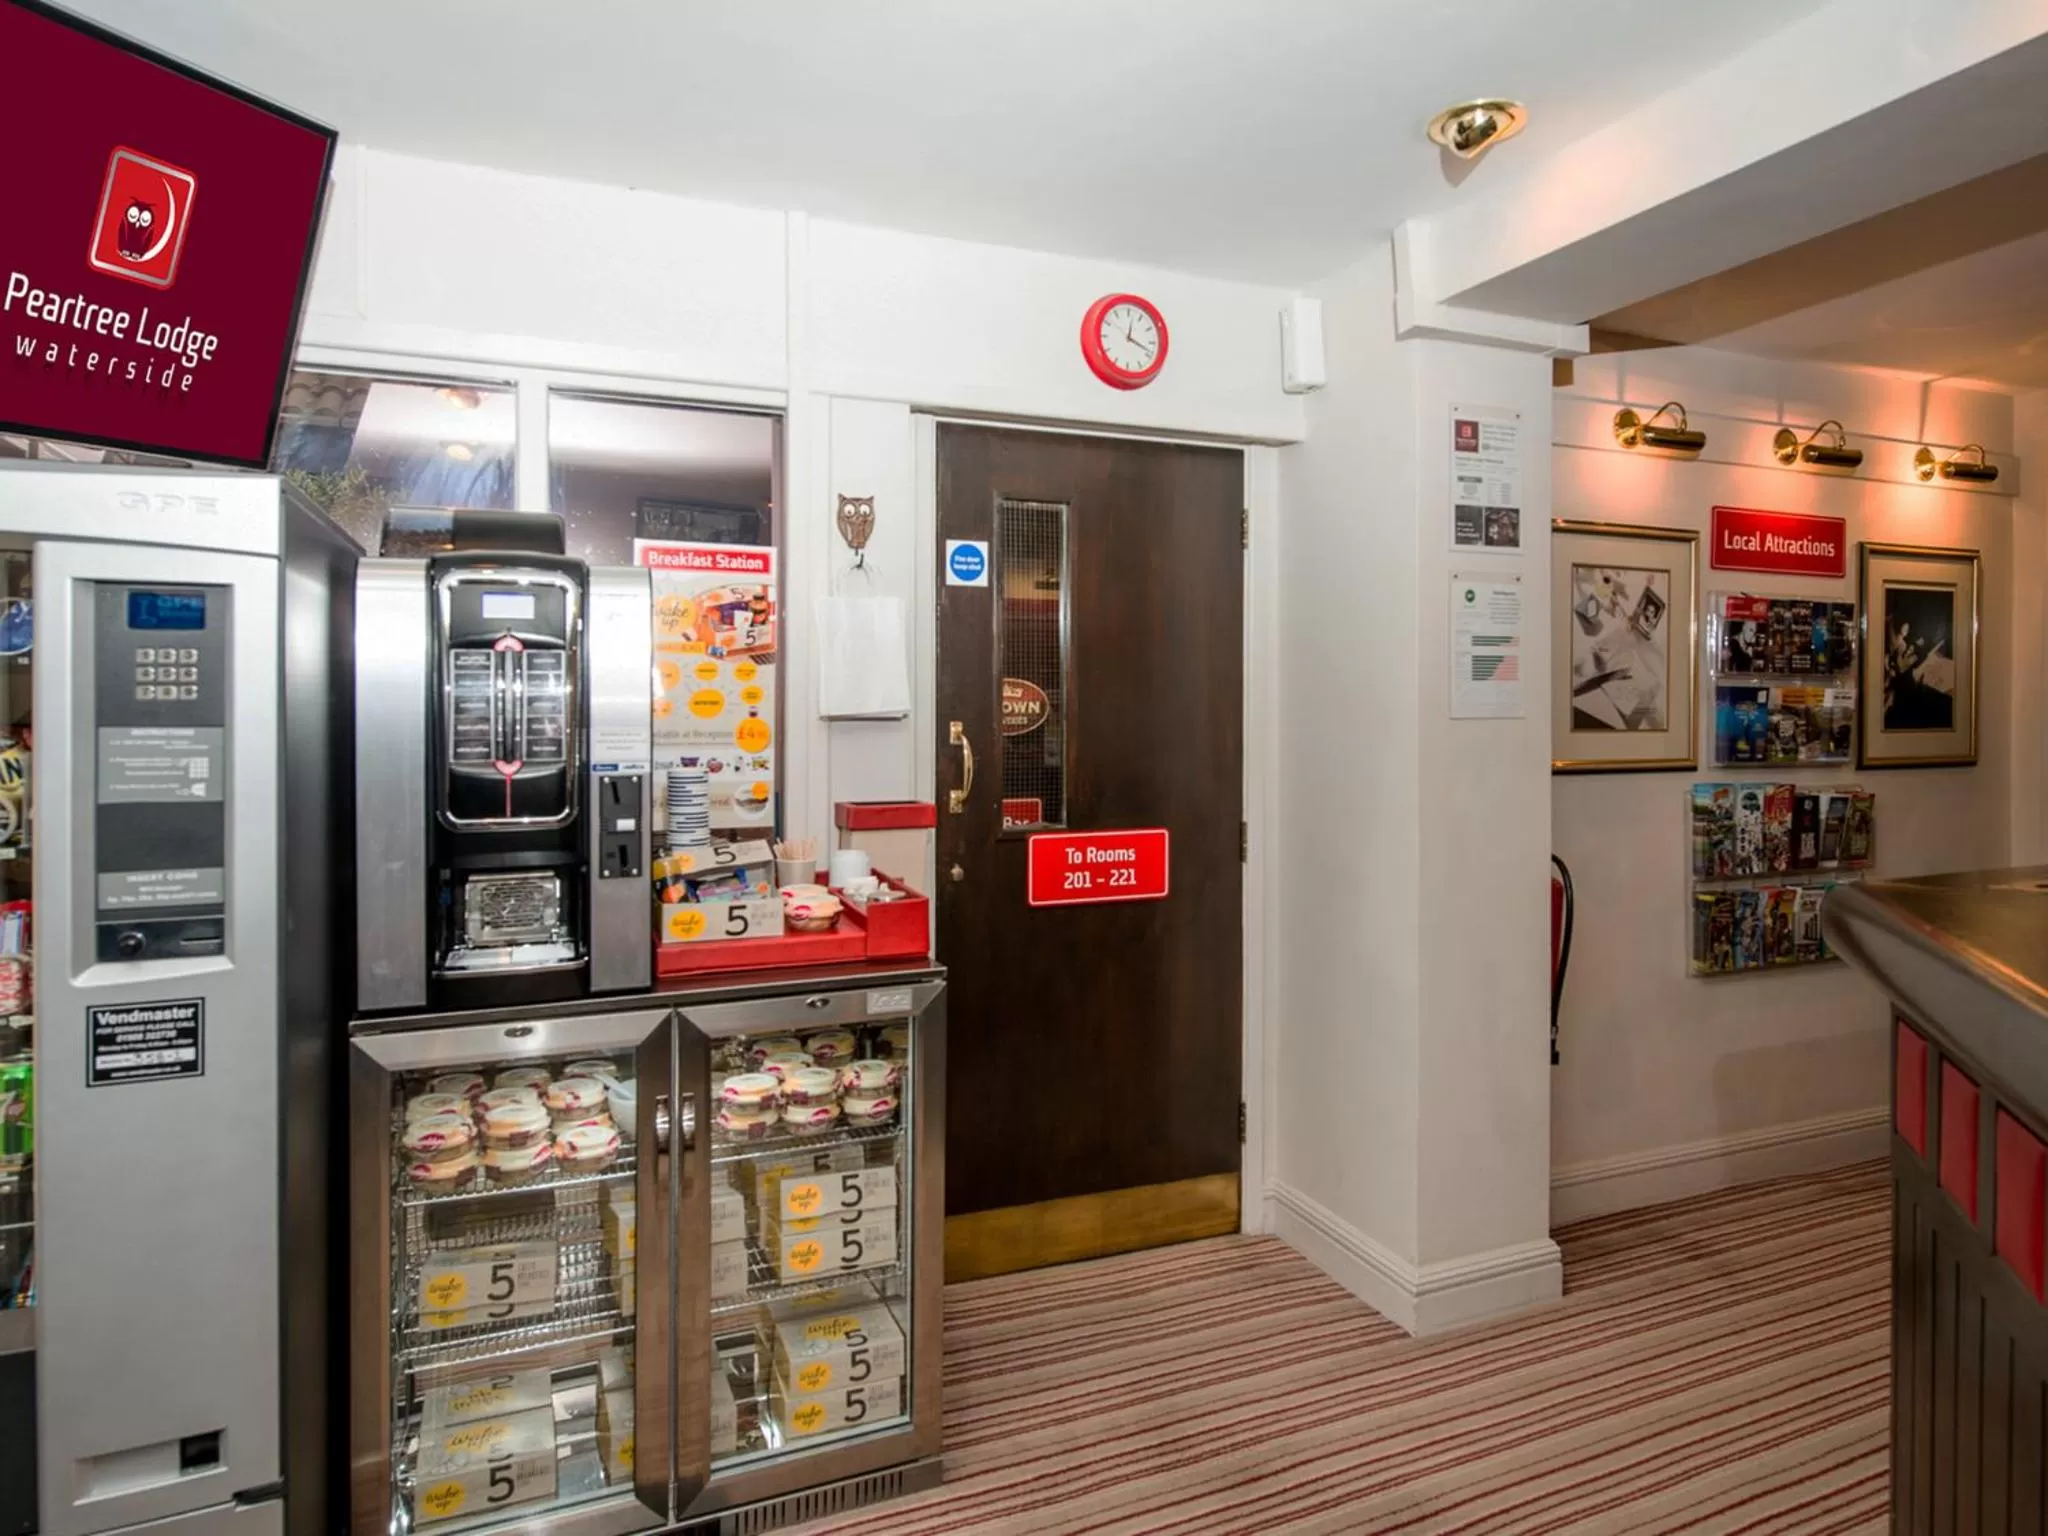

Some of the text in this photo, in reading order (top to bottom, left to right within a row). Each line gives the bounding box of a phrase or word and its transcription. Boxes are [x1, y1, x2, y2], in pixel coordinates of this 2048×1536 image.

[4, 272, 218, 368] Peartree Lodge
[16, 335, 193, 392] waterside
[1724, 529, 1836, 557] Local Attractions
[648, 551, 764, 570] Breakfast Station
[744, 629, 757, 646] 5
[1002, 701, 1040, 715] OWN
[713, 845, 737, 865] 5
[1065, 846, 1136, 864] To Rooms
[1063, 871, 1093, 889] 201
[1109, 868, 1137, 886] 221
[725, 905, 749, 936] 5
[96, 1007, 196, 1026] Vendmaster
[841, 1174, 863, 1208] 5
[841, 1229, 864, 1264] 5
[487, 1263, 516, 1301] 5
[844, 1328, 869, 1348] 5
[849, 1348, 872, 1383] 5
[844, 1388, 867, 1423] 5
[487, 1463, 515, 1504] 5
